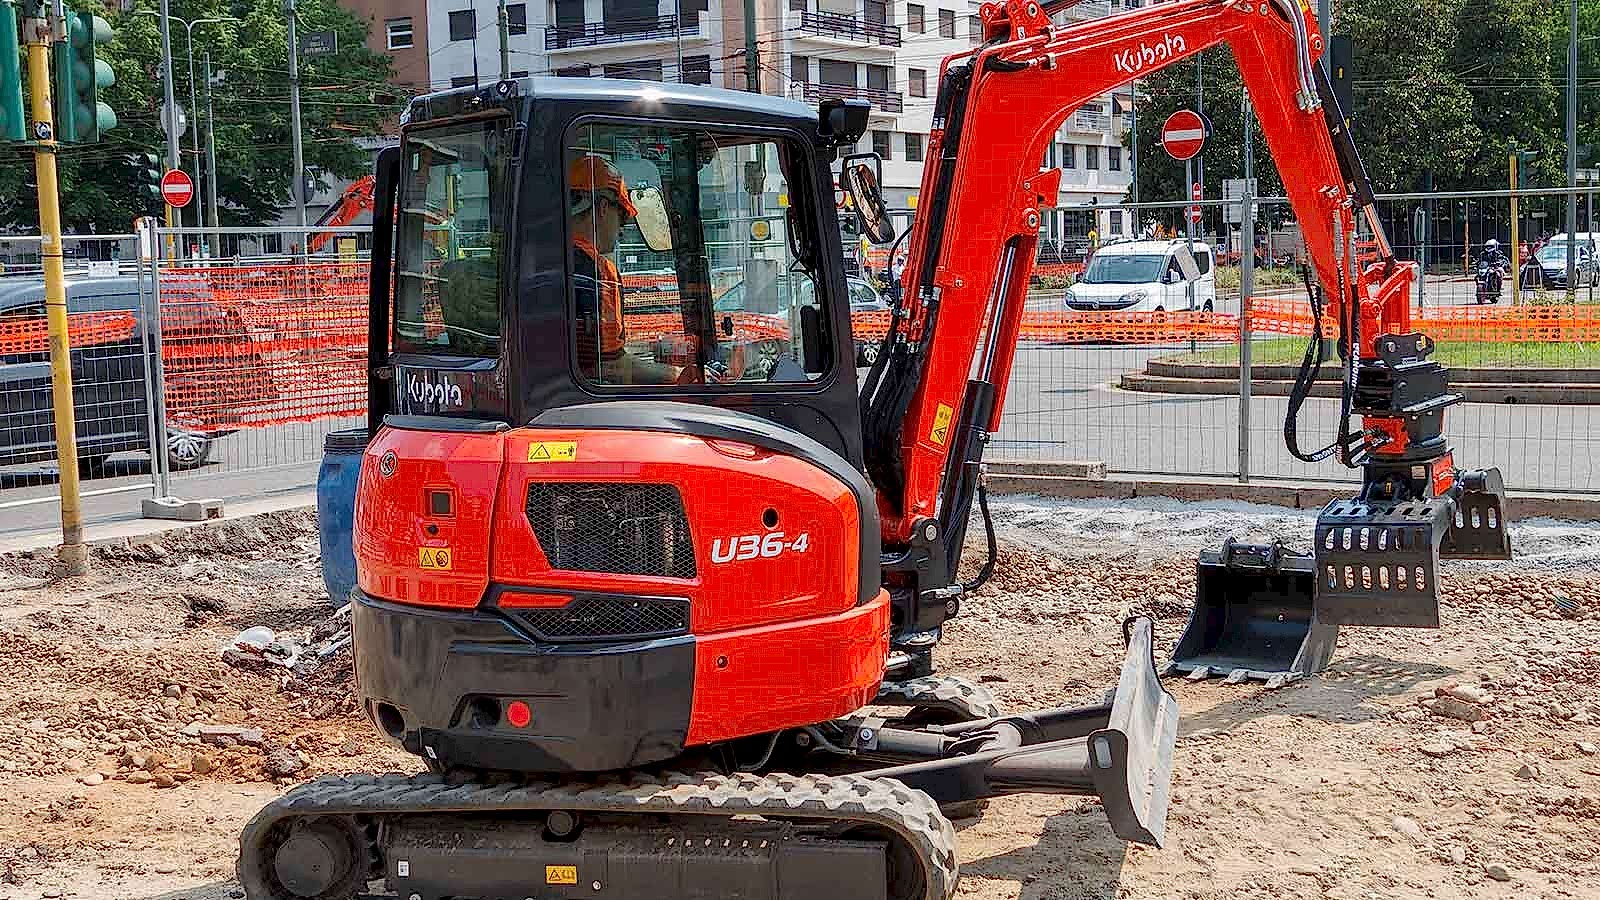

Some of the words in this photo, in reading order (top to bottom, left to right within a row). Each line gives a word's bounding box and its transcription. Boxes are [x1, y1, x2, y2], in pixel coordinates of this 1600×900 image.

[1114, 32, 1186, 73] Kubota
[407, 373, 463, 405] Kubota
[712, 532, 808, 563] U36-4
